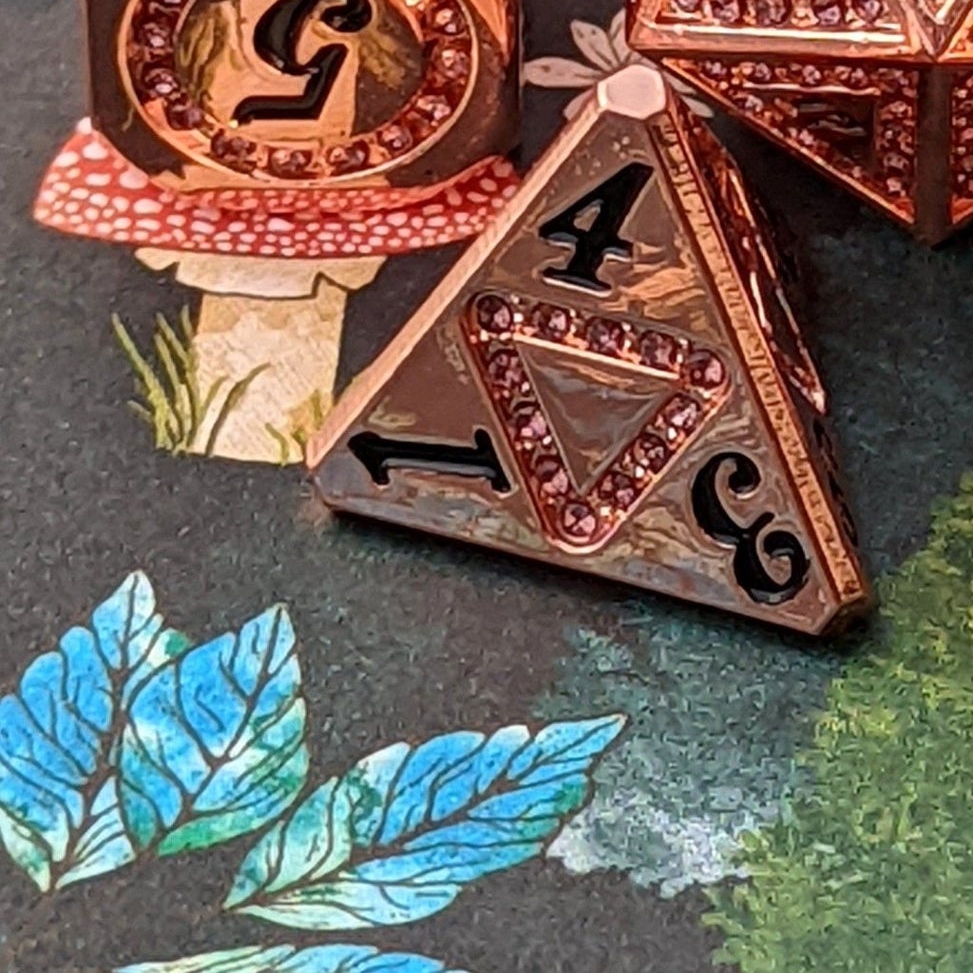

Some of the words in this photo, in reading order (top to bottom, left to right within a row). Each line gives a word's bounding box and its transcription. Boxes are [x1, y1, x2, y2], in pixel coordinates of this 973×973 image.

[540, 163, 654, 295] 4
[349, 430, 512, 496] 1
[691, 452, 811, 605] 3
